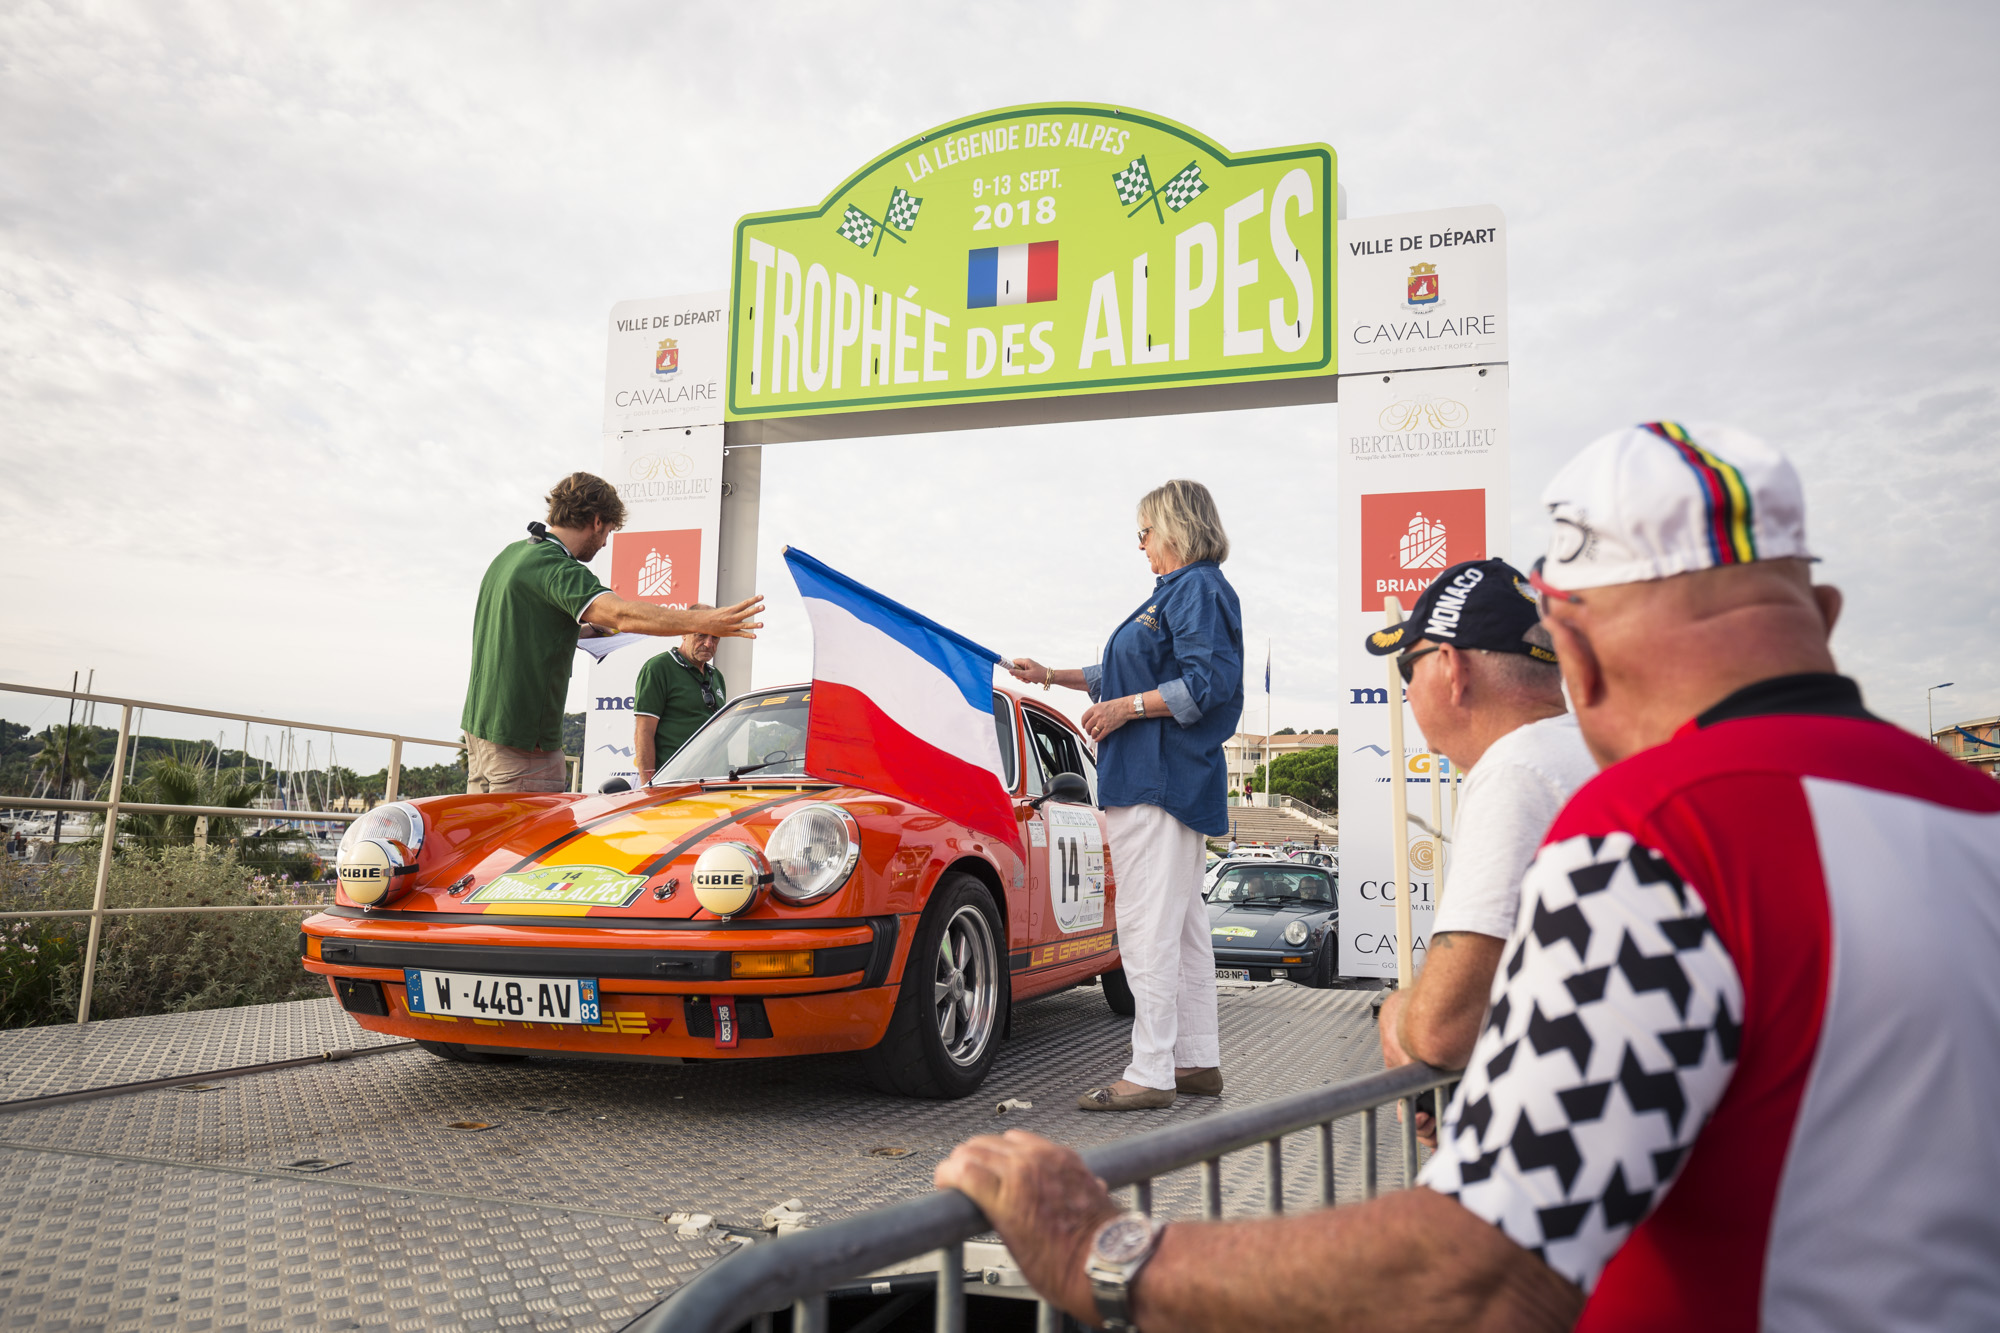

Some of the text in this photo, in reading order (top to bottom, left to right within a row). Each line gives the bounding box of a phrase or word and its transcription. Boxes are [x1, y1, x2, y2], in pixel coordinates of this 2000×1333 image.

[905, 121, 1131, 183] LA LÉGENDE DES ALPES
[972, 169, 1062, 198] 9-13 SEPT.
[972, 196, 1057, 231] 2018
[1350, 228, 1496, 256] VILLE DE DÉPART
[749, 168, 1315, 396] TROPHÉE DES ALPES
[617, 309, 722, 332] VILLE DE DÉPART
[1353, 315, 1496, 344] CAVALAIRE
[615, 382, 717, 407] CAVALAIRE
[1424, 567, 1484, 638] MONACO
[561, 872, 582, 880] 14
[1058, 836, 1080, 904] 14
[537, 890, 564, 900] DES
[565, 879, 641, 902] ALPES
[1030, 934, 1113, 967] LE GARAGE
[413, 996, 419, 1006] F
[580, 1003, 598, 1020] 83
